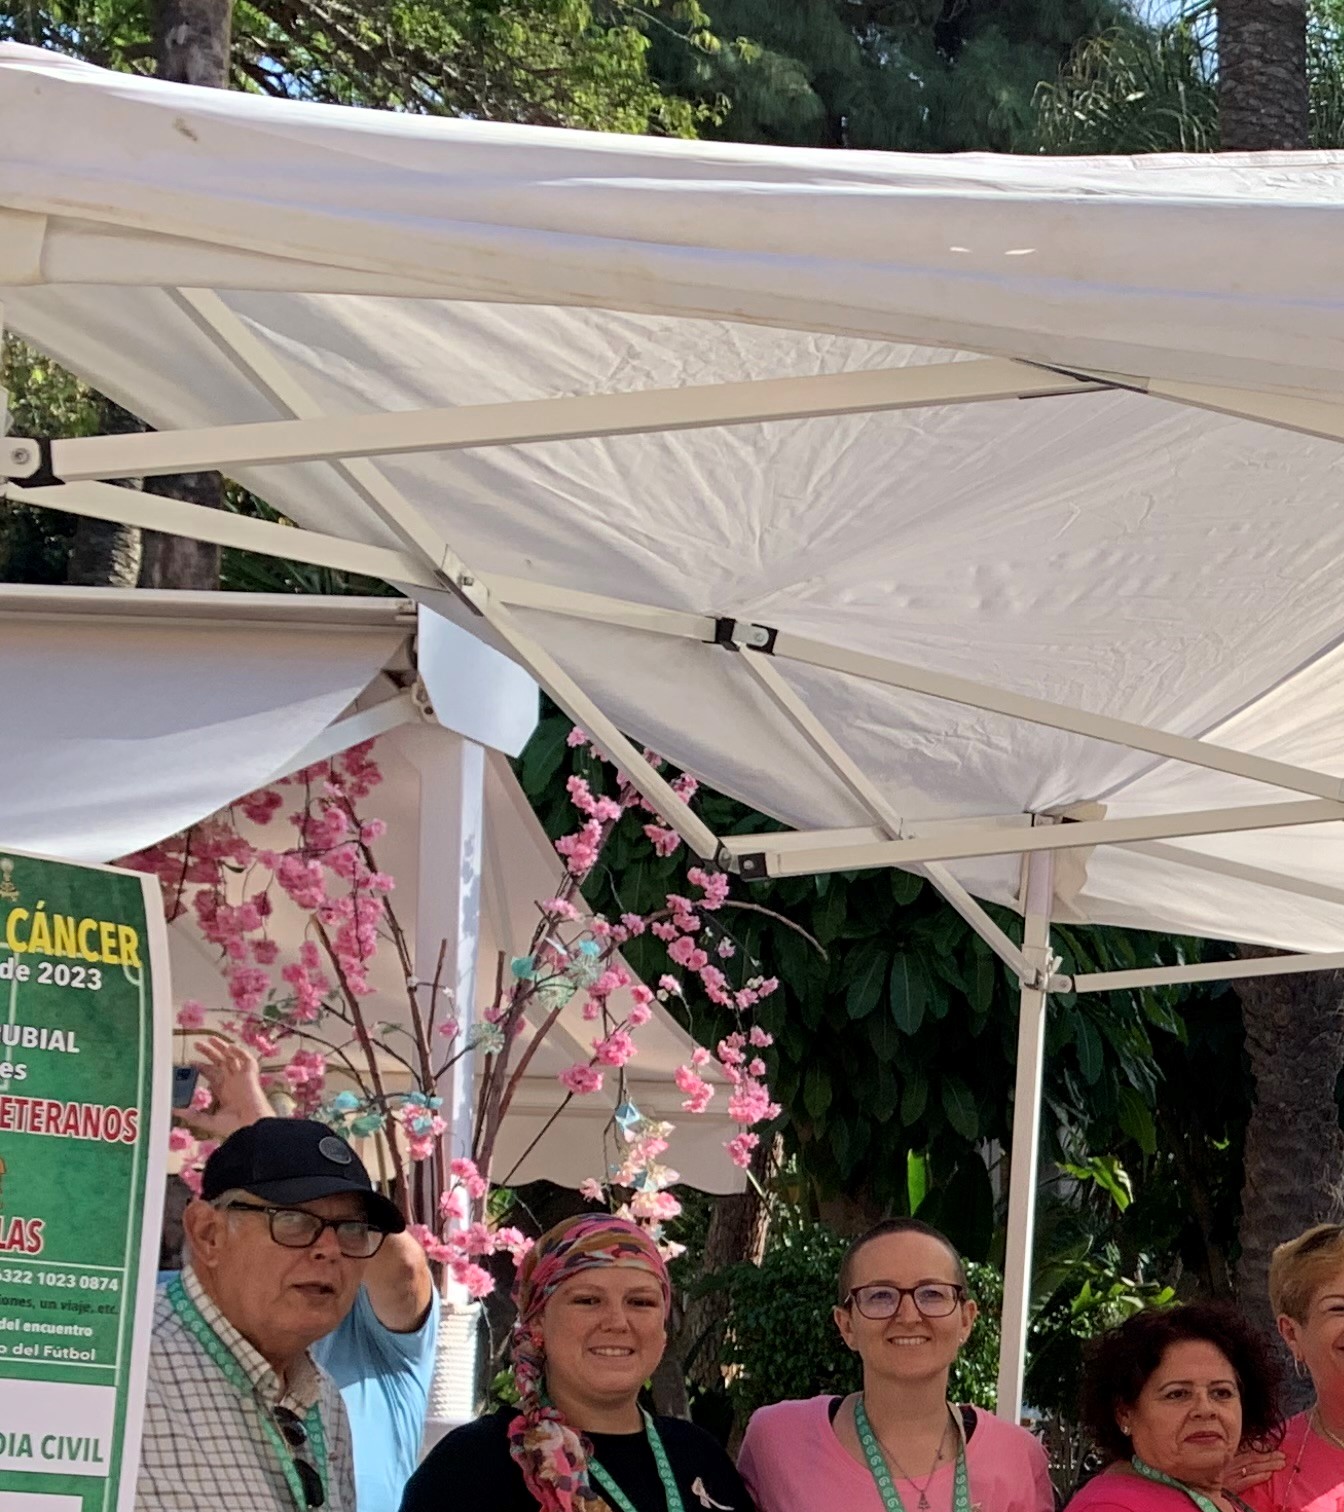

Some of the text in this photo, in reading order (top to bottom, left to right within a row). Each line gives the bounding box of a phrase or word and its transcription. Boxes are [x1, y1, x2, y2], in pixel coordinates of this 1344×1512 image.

[6, 900, 143, 968] CÁNCER
[0, 956, 103, 990] de 2023
[0, 1023, 80, 1054] UBIAL
[0, 1096, 139, 1143] ETERANOS
[37, 1271, 76, 1288] 1023
[79, 1275, 119, 1291] 0874
[23, 1321, 93, 1338] encuentro
[12, 1342, 39, 1356] del
[43, 1345, 96, 1361] Fútbol
[40, 1434, 104, 1463] CIVIL
